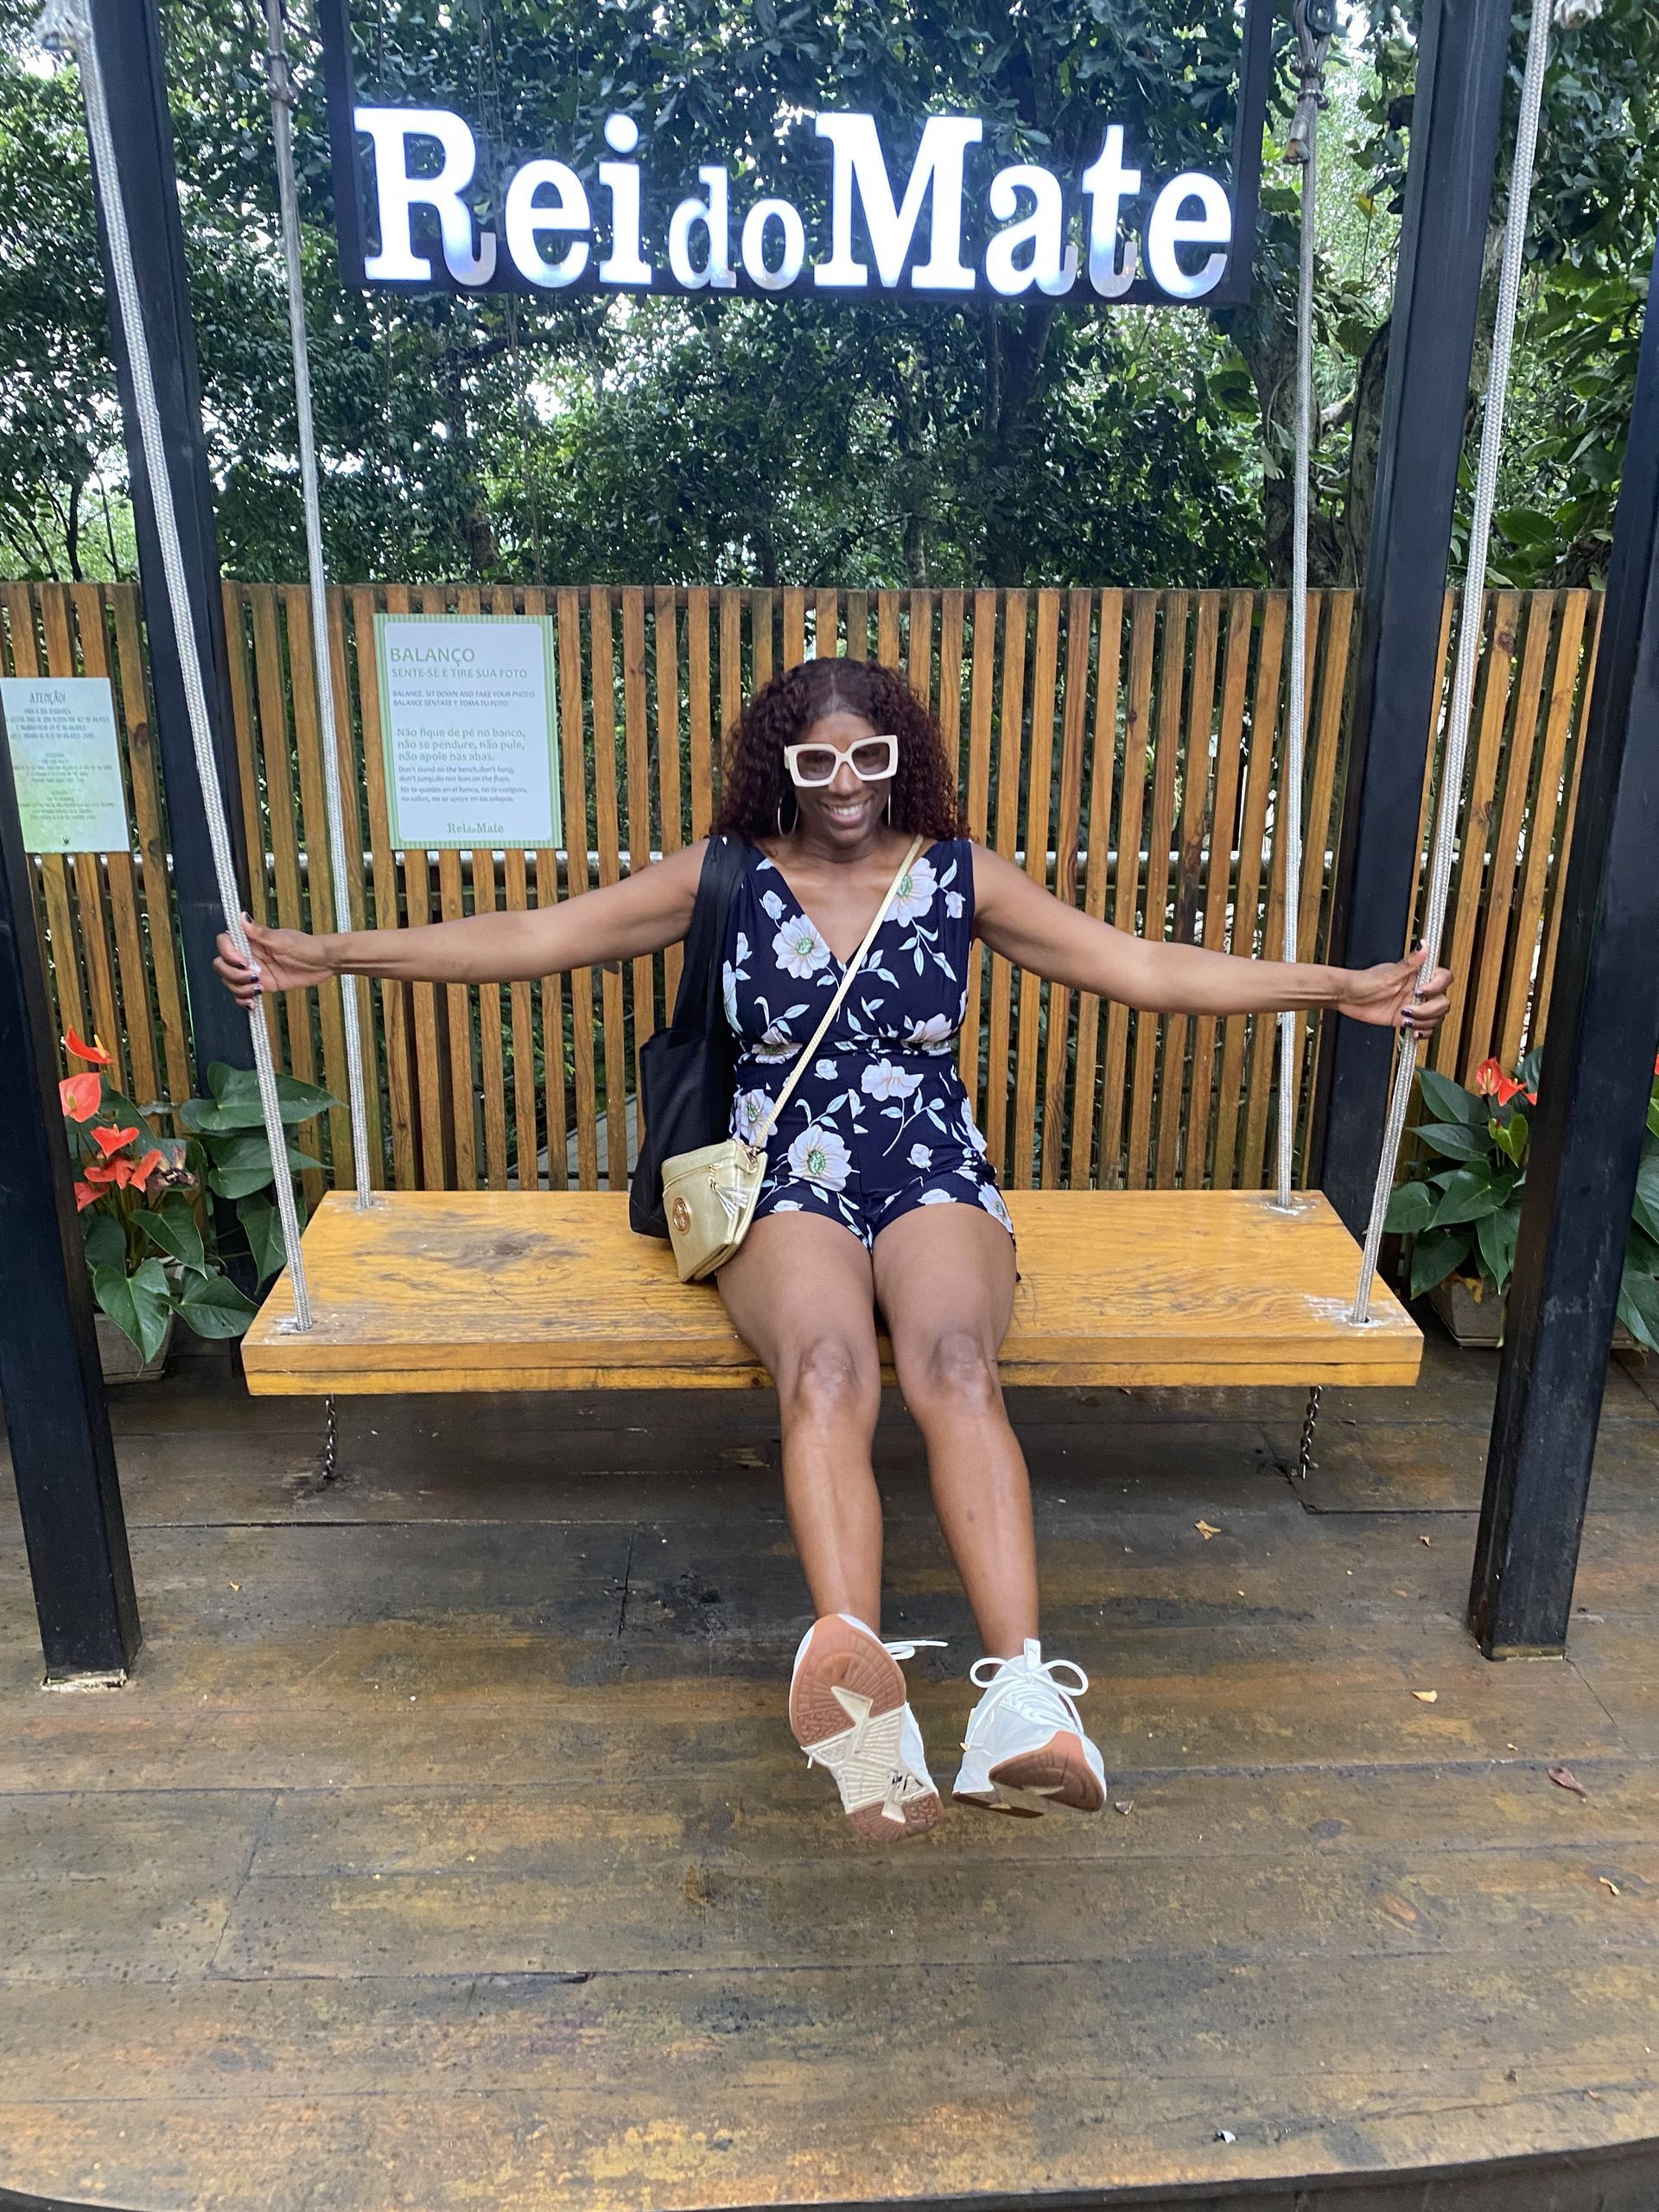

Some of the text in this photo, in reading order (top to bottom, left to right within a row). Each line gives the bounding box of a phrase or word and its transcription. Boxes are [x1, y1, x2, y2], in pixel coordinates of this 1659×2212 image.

[390, 647, 476, 667] BALANÇO
[391, 668, 528, 679] SENTE-SE E TIRE SUA FOTO
[397, 728, 417, 737] Não
[420, 727, 446, 739] fique
[448, 728, 461, 737] de
[462, 728, 474, 740] pé
[492, 728, 526, 739] banco,
[397, 739, 416, 749] não
[432, 739, 477, 752] pendure,
[480, 739, 499, 749] não
[500, 739, 525, 752] pule,
[398, 751, 418, 760] não
[469, 751, 495, 761] abas.
